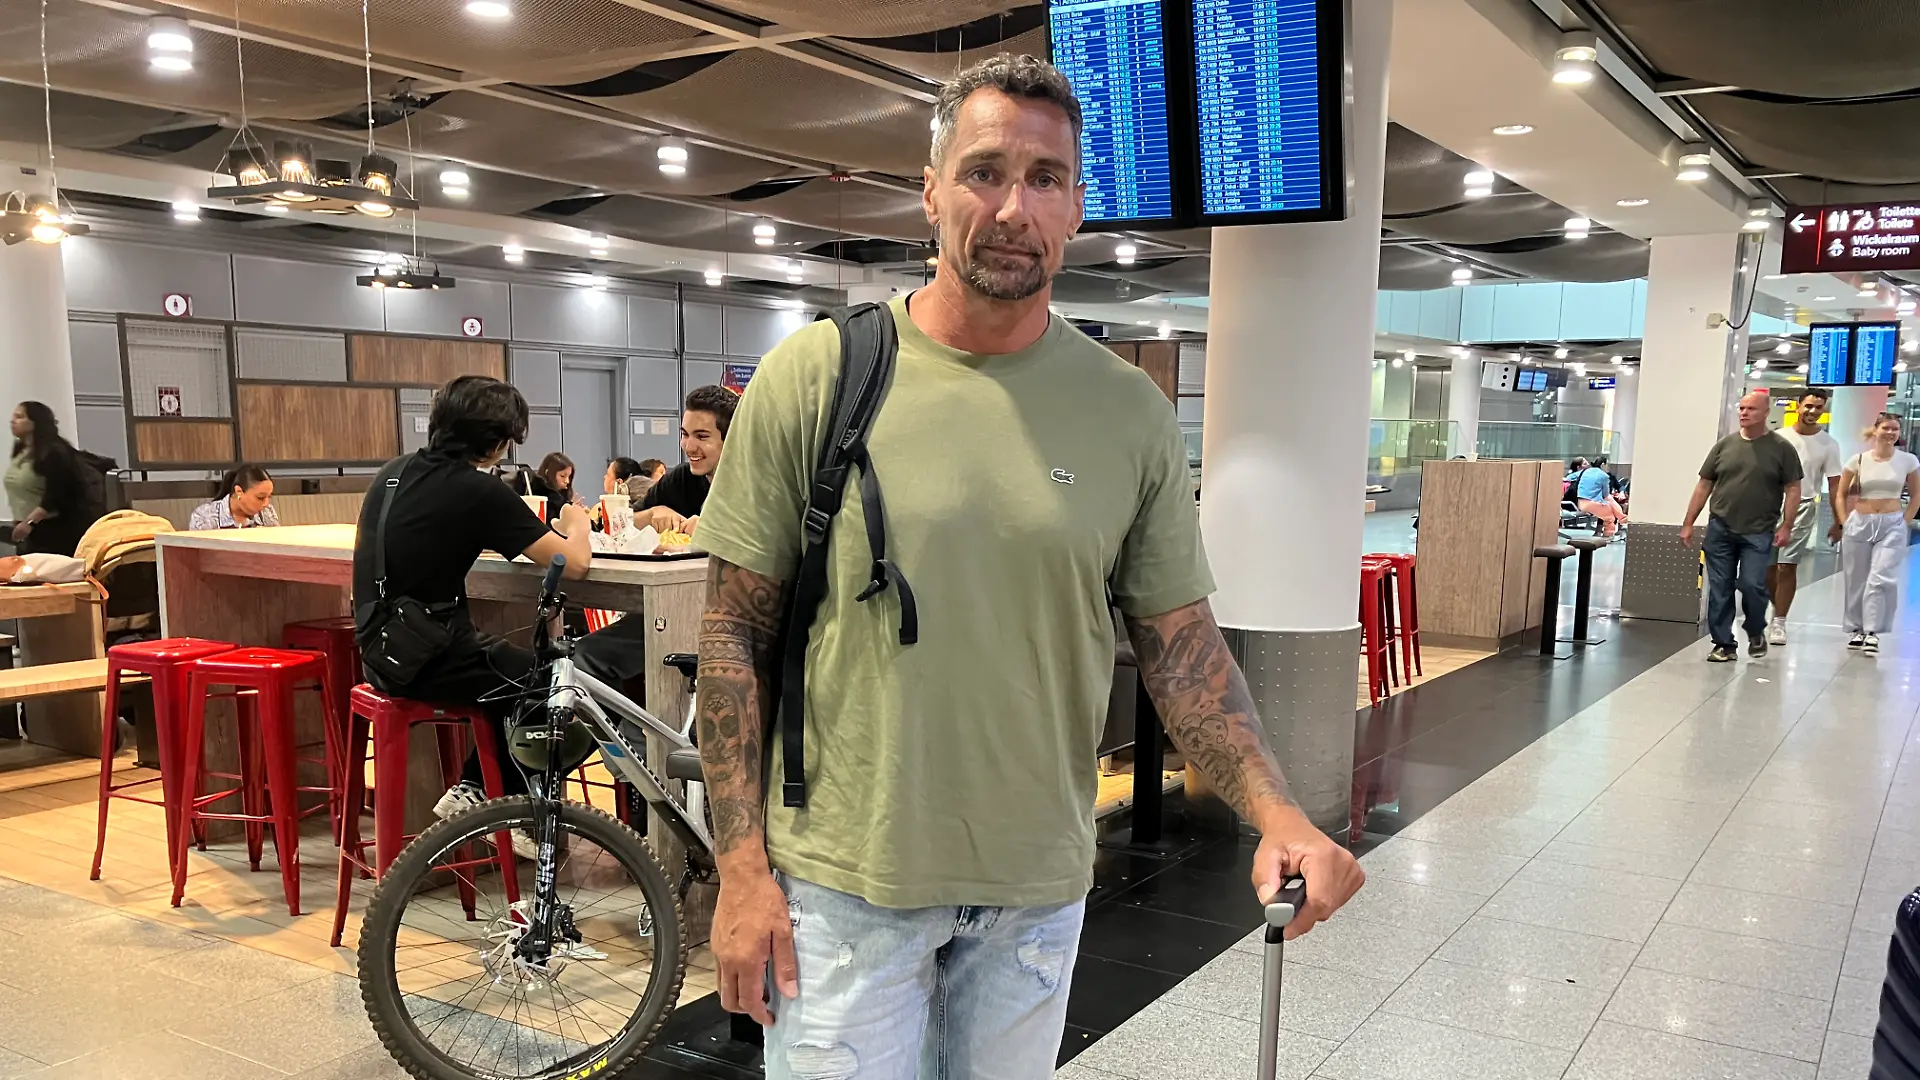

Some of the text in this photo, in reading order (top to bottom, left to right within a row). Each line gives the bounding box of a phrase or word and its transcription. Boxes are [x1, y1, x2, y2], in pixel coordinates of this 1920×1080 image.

[1878, 218, 1914, 229] Toilets
[1852, 233, 1920, 245] Wickelraum
[1852, 246, 1910, 258] Baby room
